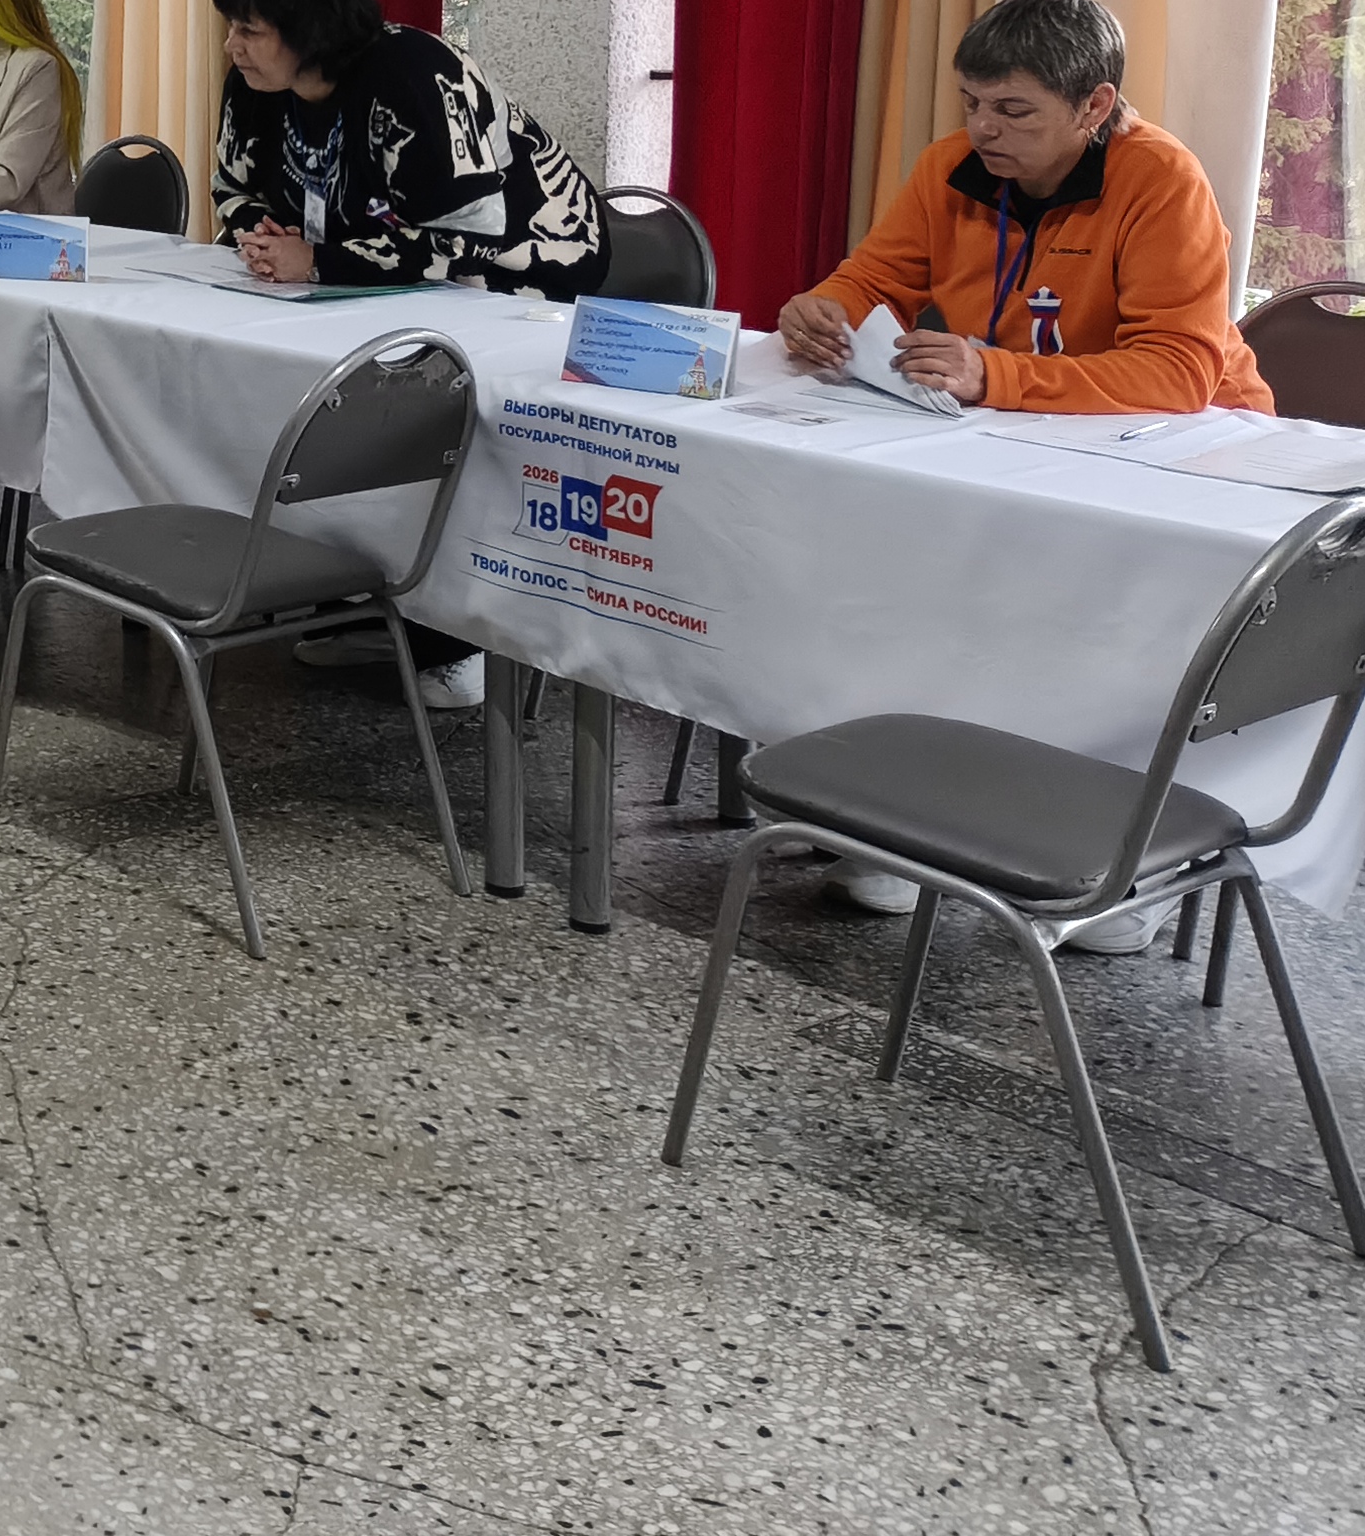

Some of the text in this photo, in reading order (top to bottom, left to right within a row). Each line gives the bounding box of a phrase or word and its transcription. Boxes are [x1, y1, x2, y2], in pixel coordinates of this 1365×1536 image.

[472, 244, 501, 261] MO
[503, 398, 678, 449] ВЫБОРЫ ДЕПУТАТОВ
[498, 423, 680, 475] ГОСУДАРСТВЕННОЙ ДУМЫ
[522, 464, 559, 484] 2026
[526, 487, 649, 532] 18 19 20
[569, 537, 654, 573] СЕНТЯБРЯ
[470, 552, 509, 578] ТВОЙ
[511, 567, 568, 592] ГОЛОС
[586, 585, 629, 611] СИЛА
[633, 599, 708, 634] РОССИИ!
